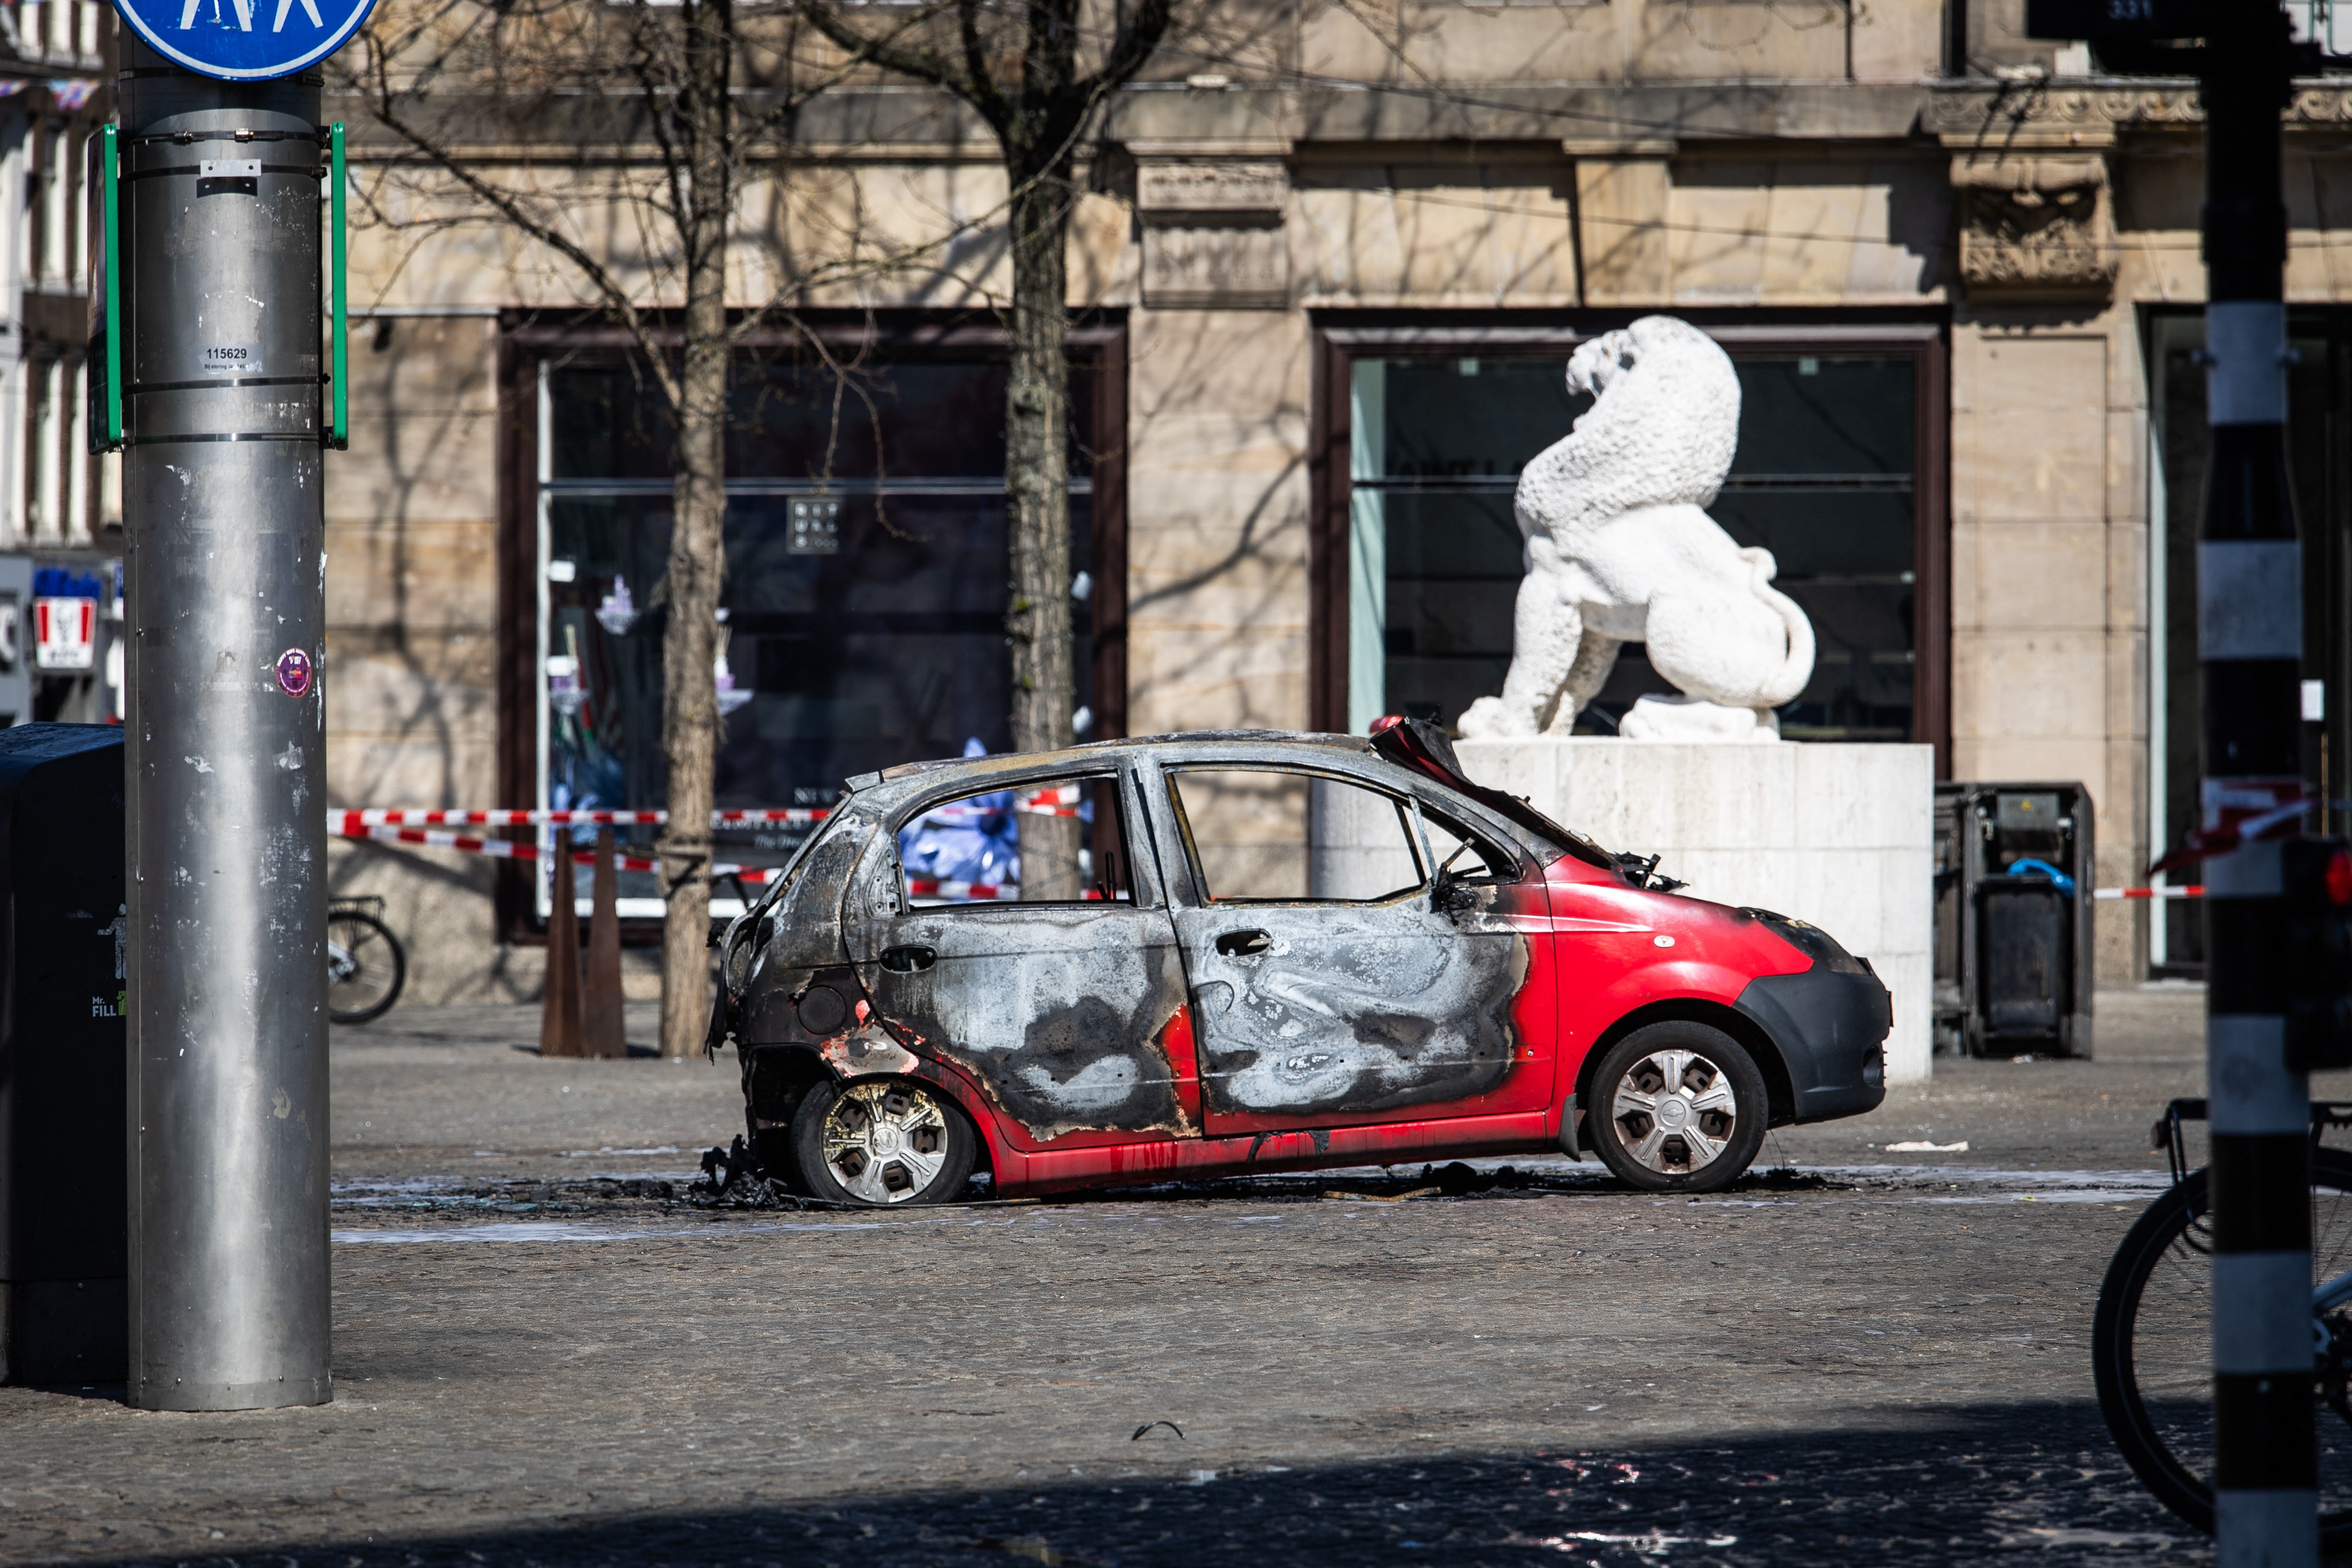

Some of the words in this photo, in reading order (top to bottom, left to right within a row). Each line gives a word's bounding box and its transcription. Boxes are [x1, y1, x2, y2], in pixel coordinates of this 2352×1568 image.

[207, 349, 247, 359] 115629
[92, 996, 105, 1004] Mr.
[92, 1004, 117, 1017] FILL
